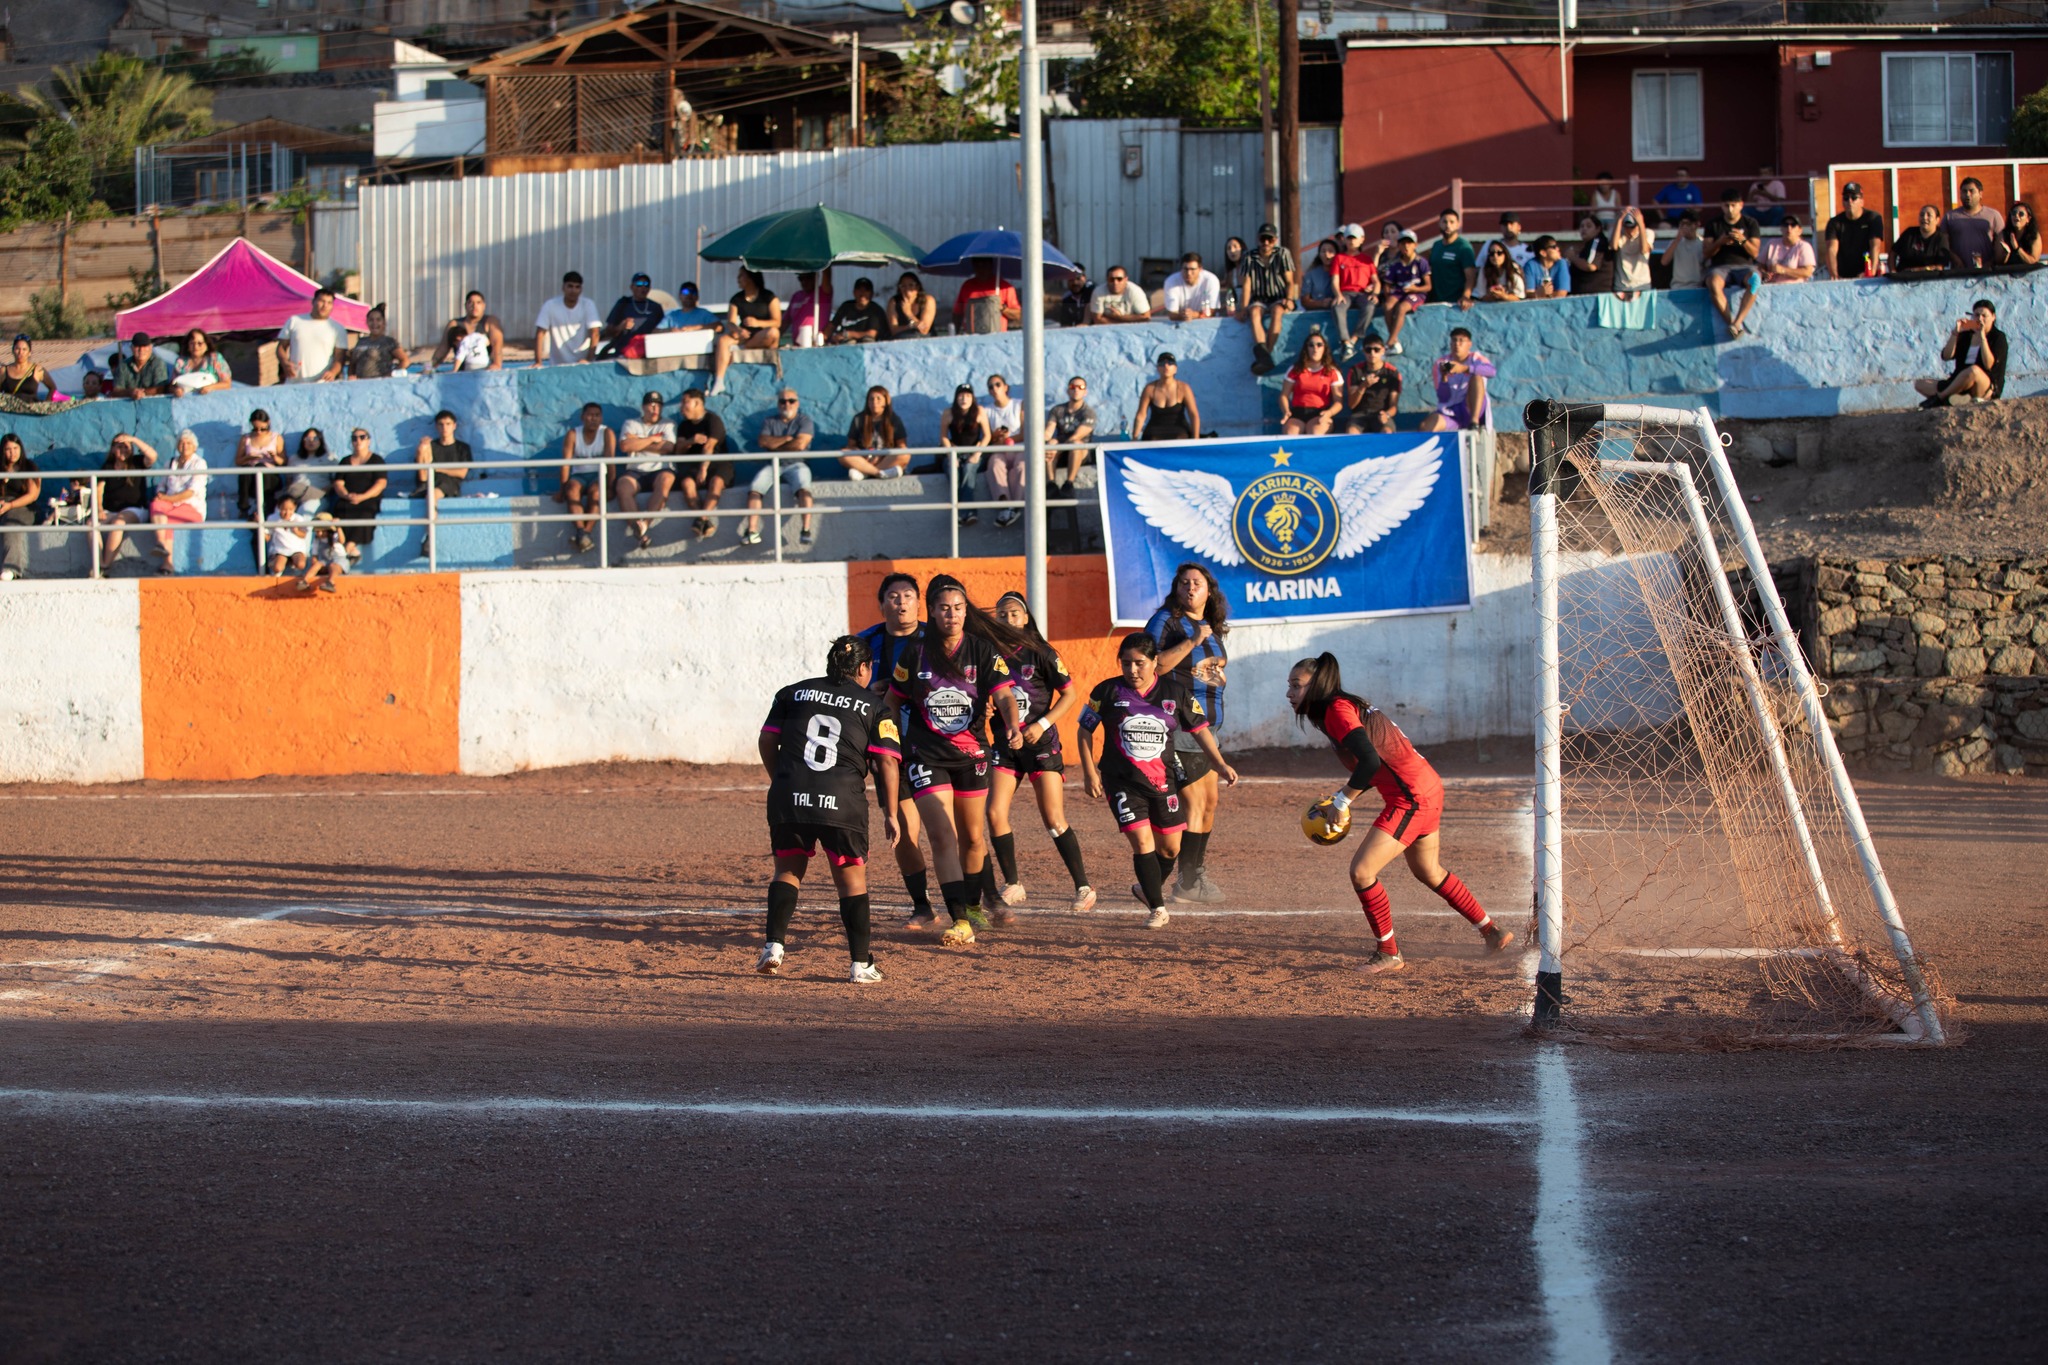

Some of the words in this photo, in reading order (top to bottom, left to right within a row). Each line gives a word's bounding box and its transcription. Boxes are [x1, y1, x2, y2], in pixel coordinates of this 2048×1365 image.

[1248, 476, 1301, 500] KARINA
[1303, 482, 1323, 498] FC
[1245, 576, 1342, 603] KARINA
[794, 689, 852, 709] CHAVELAS
[853, 699, 870, 716] FC
[928, 705, 968, 717] ENRÍQUEZ
[803, 713, 842, 772] 8
[793, 792, 813, 807] TAL
[818, 794, 839, 810] TAL
[1115, 791, 1131, 814] 2
